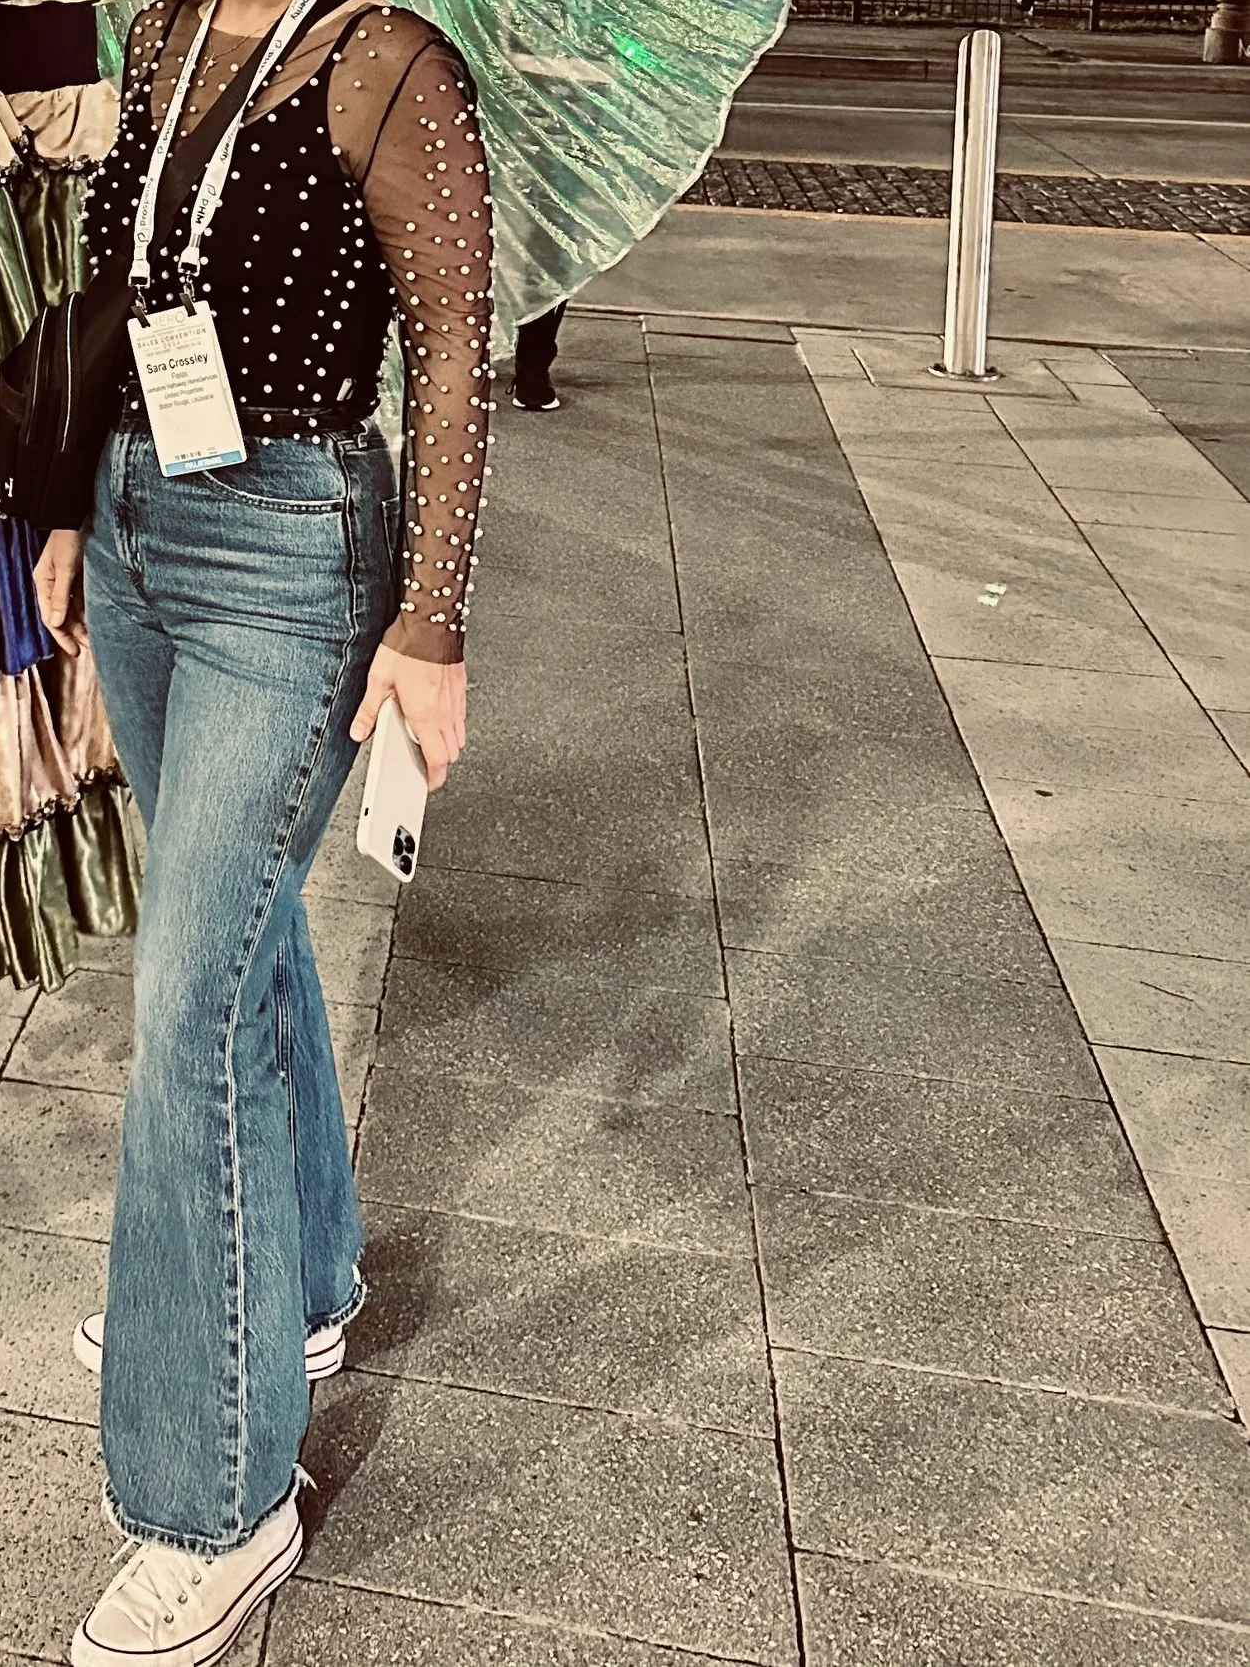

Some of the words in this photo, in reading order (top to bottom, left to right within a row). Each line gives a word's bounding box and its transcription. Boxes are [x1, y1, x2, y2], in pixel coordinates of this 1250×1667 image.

[195, 198, 209, 225] PHM
[146, 363, 167, 374] Sara
[168, 353, 208, 370] Crossley
